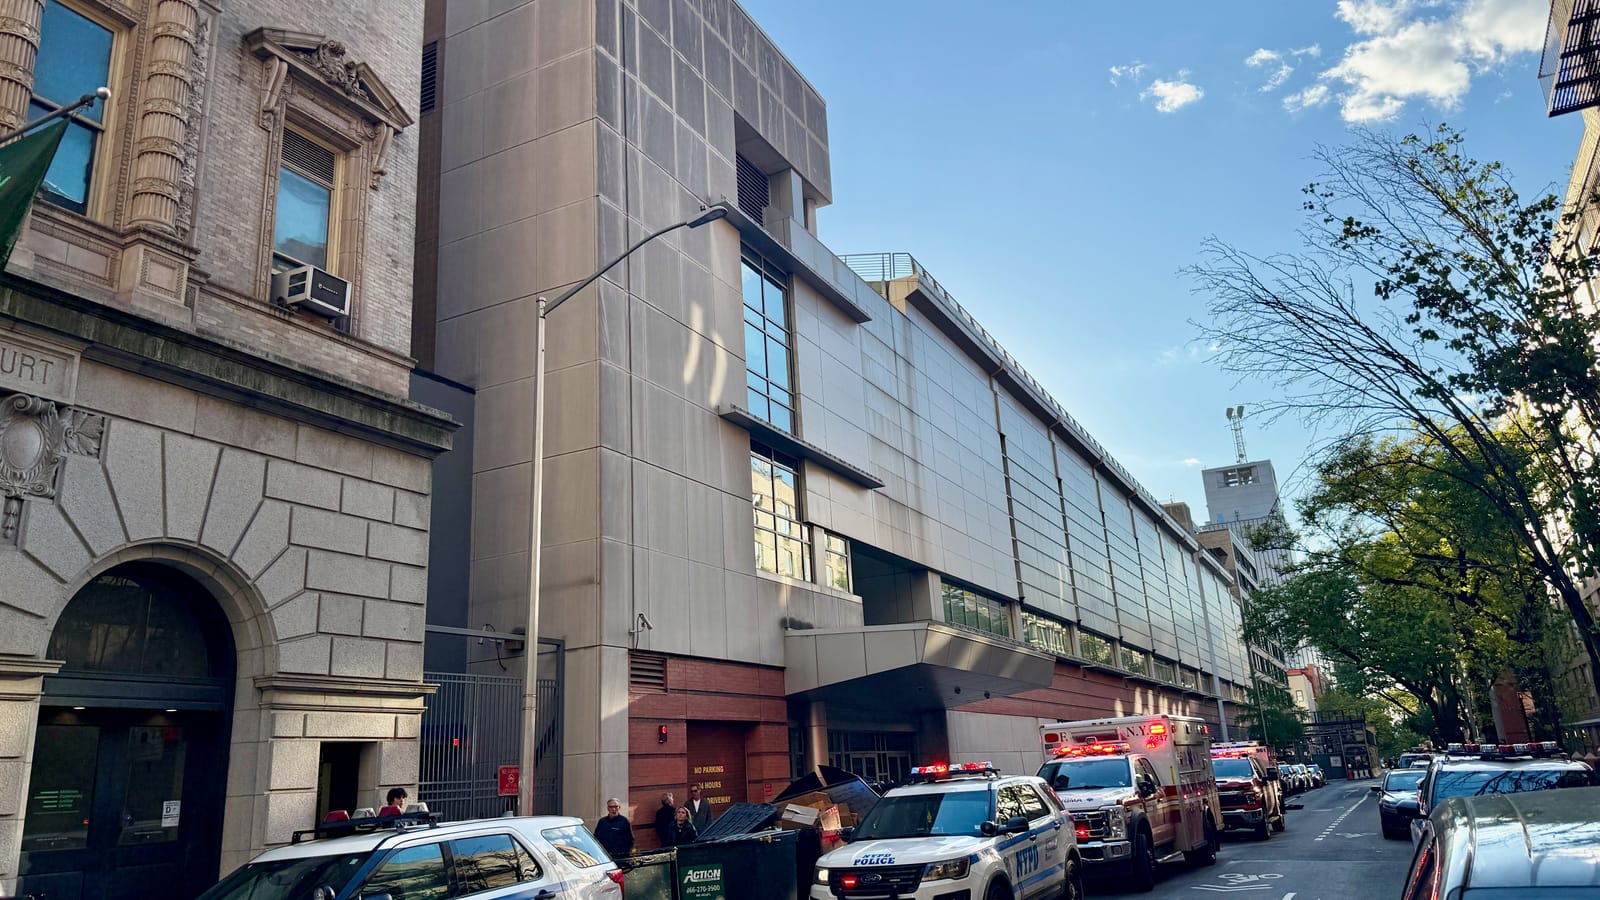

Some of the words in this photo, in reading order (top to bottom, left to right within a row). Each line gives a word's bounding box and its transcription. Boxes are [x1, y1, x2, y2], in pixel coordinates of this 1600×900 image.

[694, 766, 702, 774] NO
[703, 765, 724, 773] PARKING
[853, 857, 896, 865] POLICE
[1015, 844, 1039, 878] NYPD
[683, 869, 721, 884] ACTION
